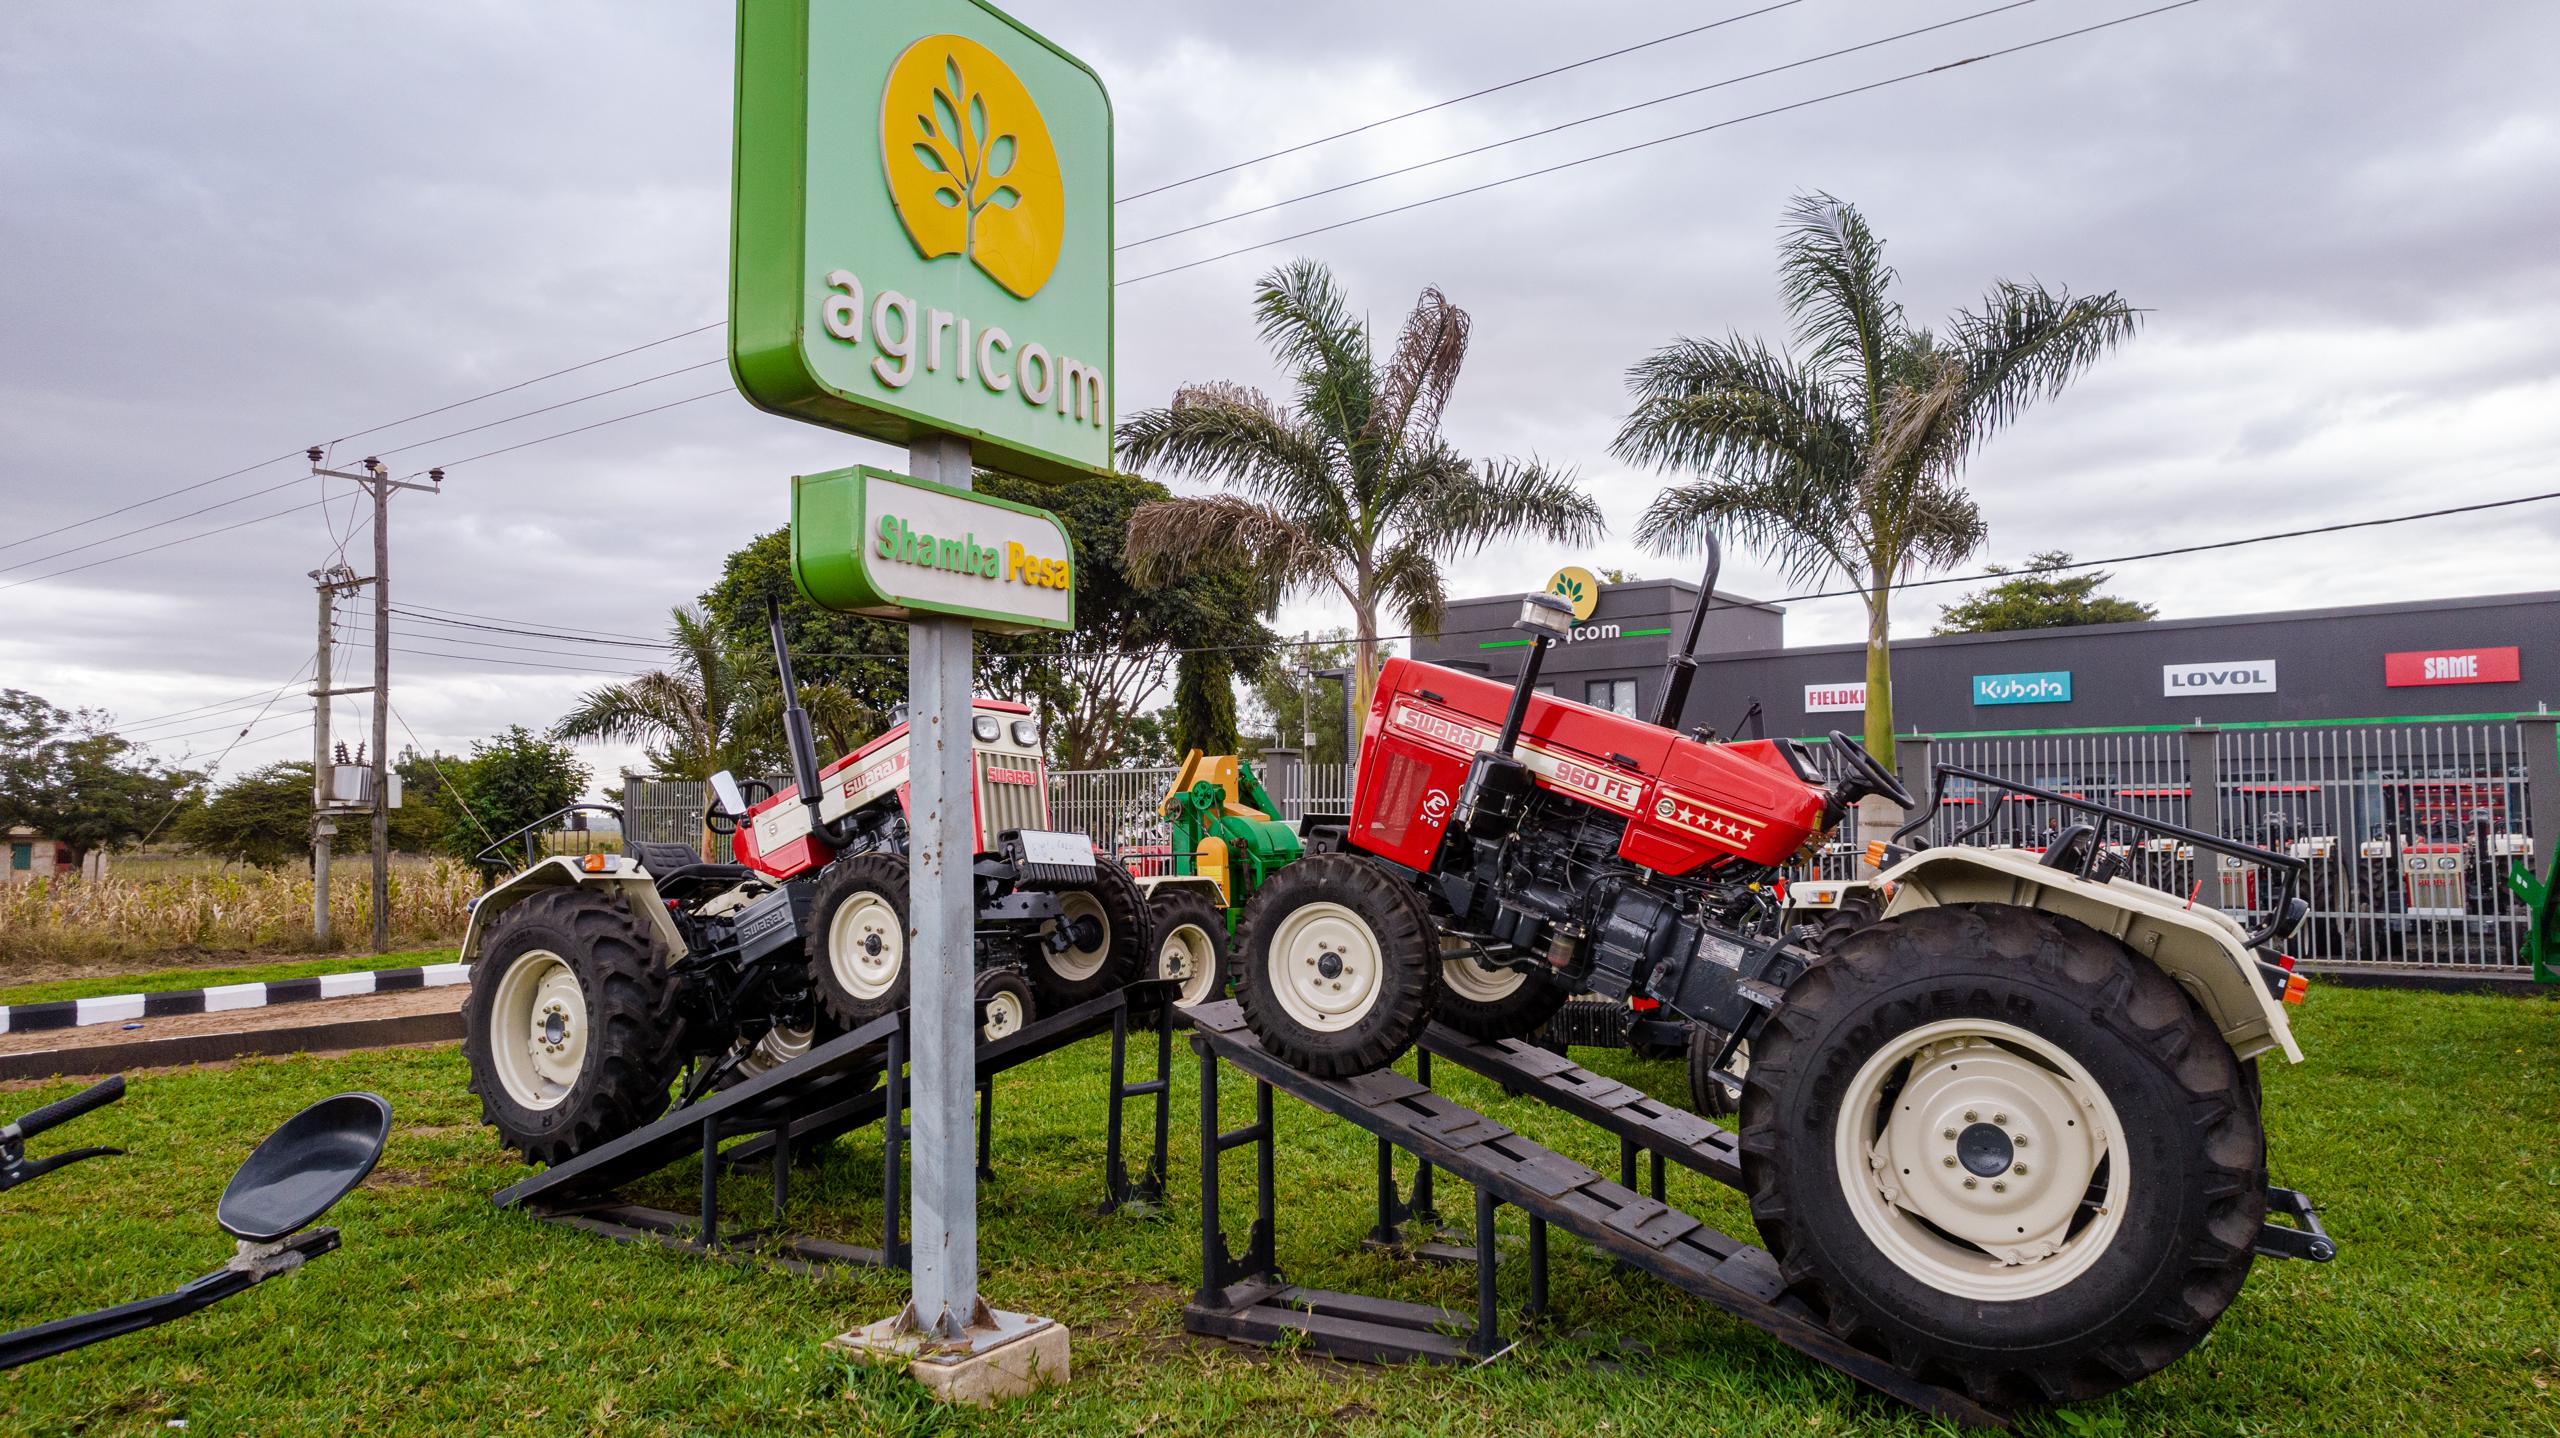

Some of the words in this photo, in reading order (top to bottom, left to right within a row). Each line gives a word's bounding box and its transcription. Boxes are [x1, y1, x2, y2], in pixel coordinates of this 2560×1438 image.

[822, 270, 1103, 427] agricom
[875, 514, 1000, 579] Shamba
[1004, 540, 1070, 590] Pesa
[2424, 655, 2478, 679] SAME
[1981, 679, 2063, 699] Kubota
[2172, 670, 2267, 687] LOVOL
[1809, 689, 1865, 706] FIELDKI
[1555, 762, 1600, 791] 960
[1603, 778, 1632, 803] FE
[1420, 814, 1439, 828] PTO
